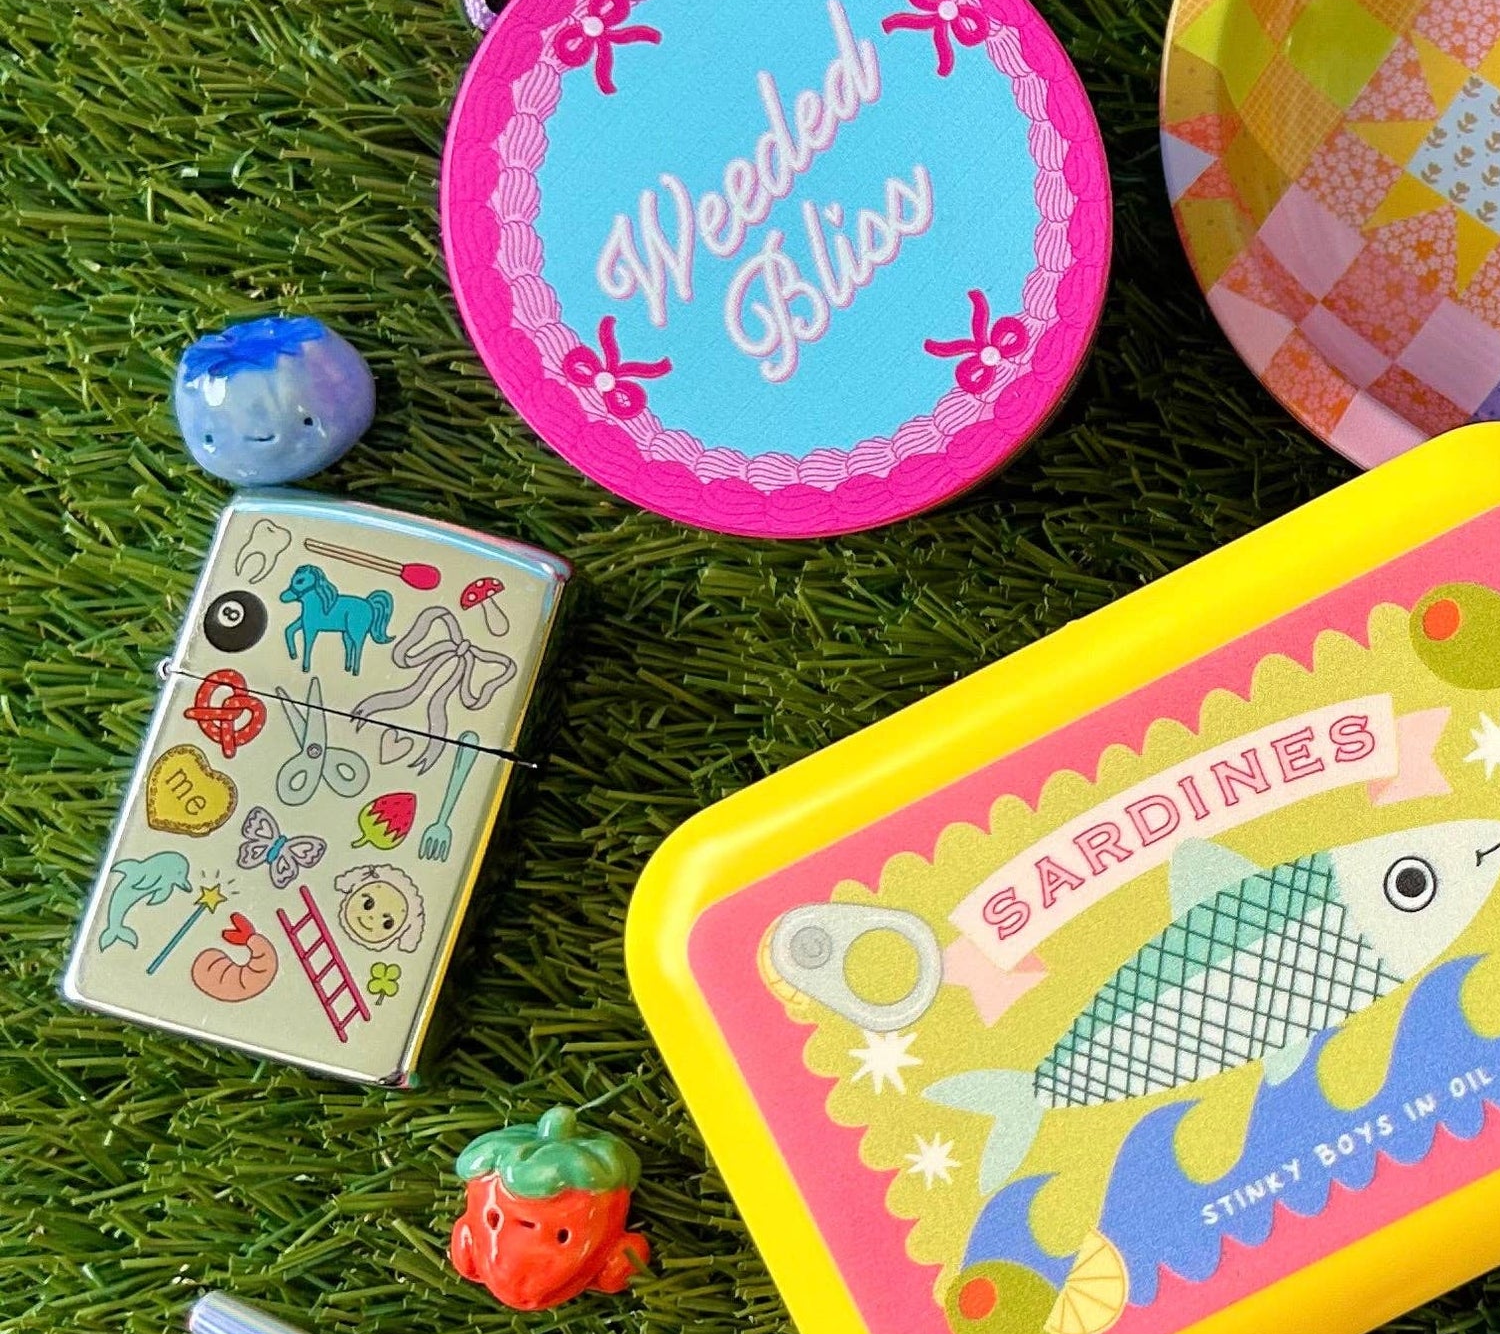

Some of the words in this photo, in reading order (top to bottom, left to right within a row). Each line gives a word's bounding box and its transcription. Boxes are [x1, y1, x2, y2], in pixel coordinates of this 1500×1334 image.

[724, 163, 934, 383] Bliss
[165, 768, 207, 816] me
[982, 714, 1376, 940] SARDINES
[1201, 1158, 1301, 1225] STINKY
[1314, 1114, 1393, 1167] BOYS
[1402, 1093, 1436, 1121] IN
[1449, 1067, 1493, 1098] OIL
